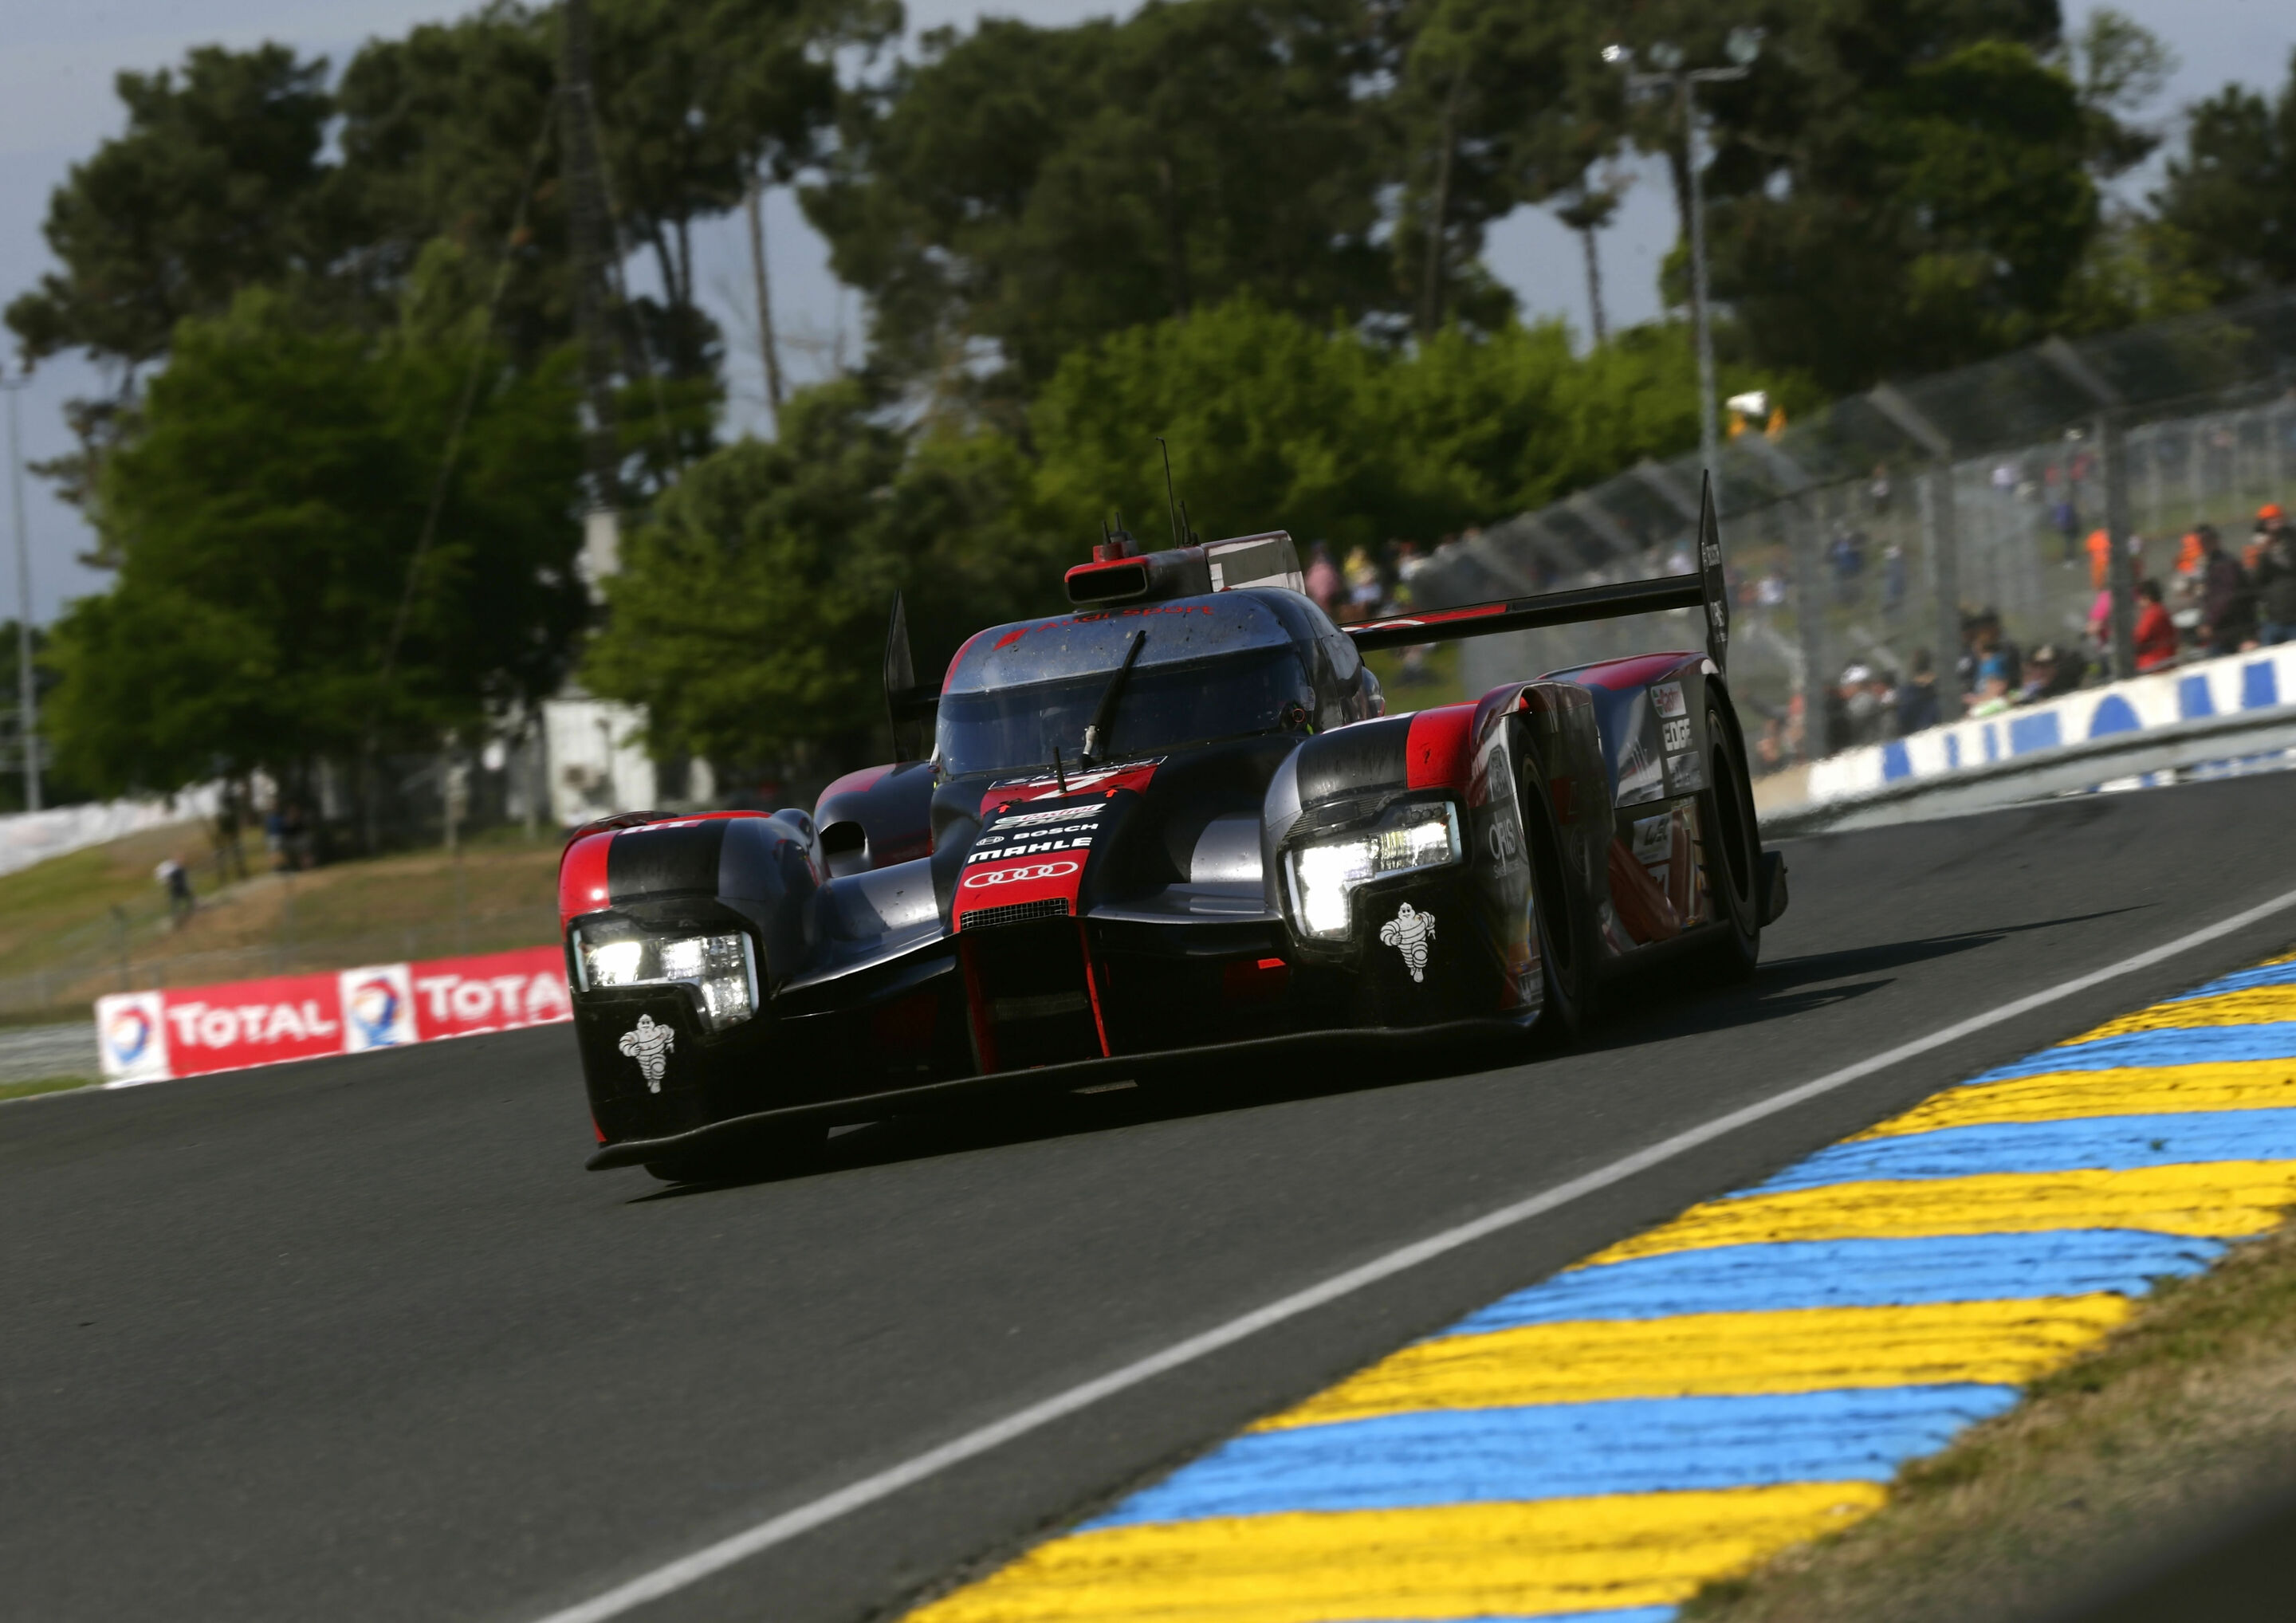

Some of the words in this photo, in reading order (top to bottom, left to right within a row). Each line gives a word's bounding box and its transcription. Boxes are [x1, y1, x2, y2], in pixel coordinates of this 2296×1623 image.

[1122, 605, 1214, 617] sport
[1662, 718, 1693, 752] EDGE
[987, 810, 1105, 833] EDGE
[1022, 804, 1097, 822] Castrol
[1012, 823, 1099, 840] BOSCH
[1488, 818, 1516, 860] ORIS
[967, 837, 1093, 863] MAHLE
[416, 971, 573, 1022] TOTA
[166, 1000, 339, 1049] TOTAL
